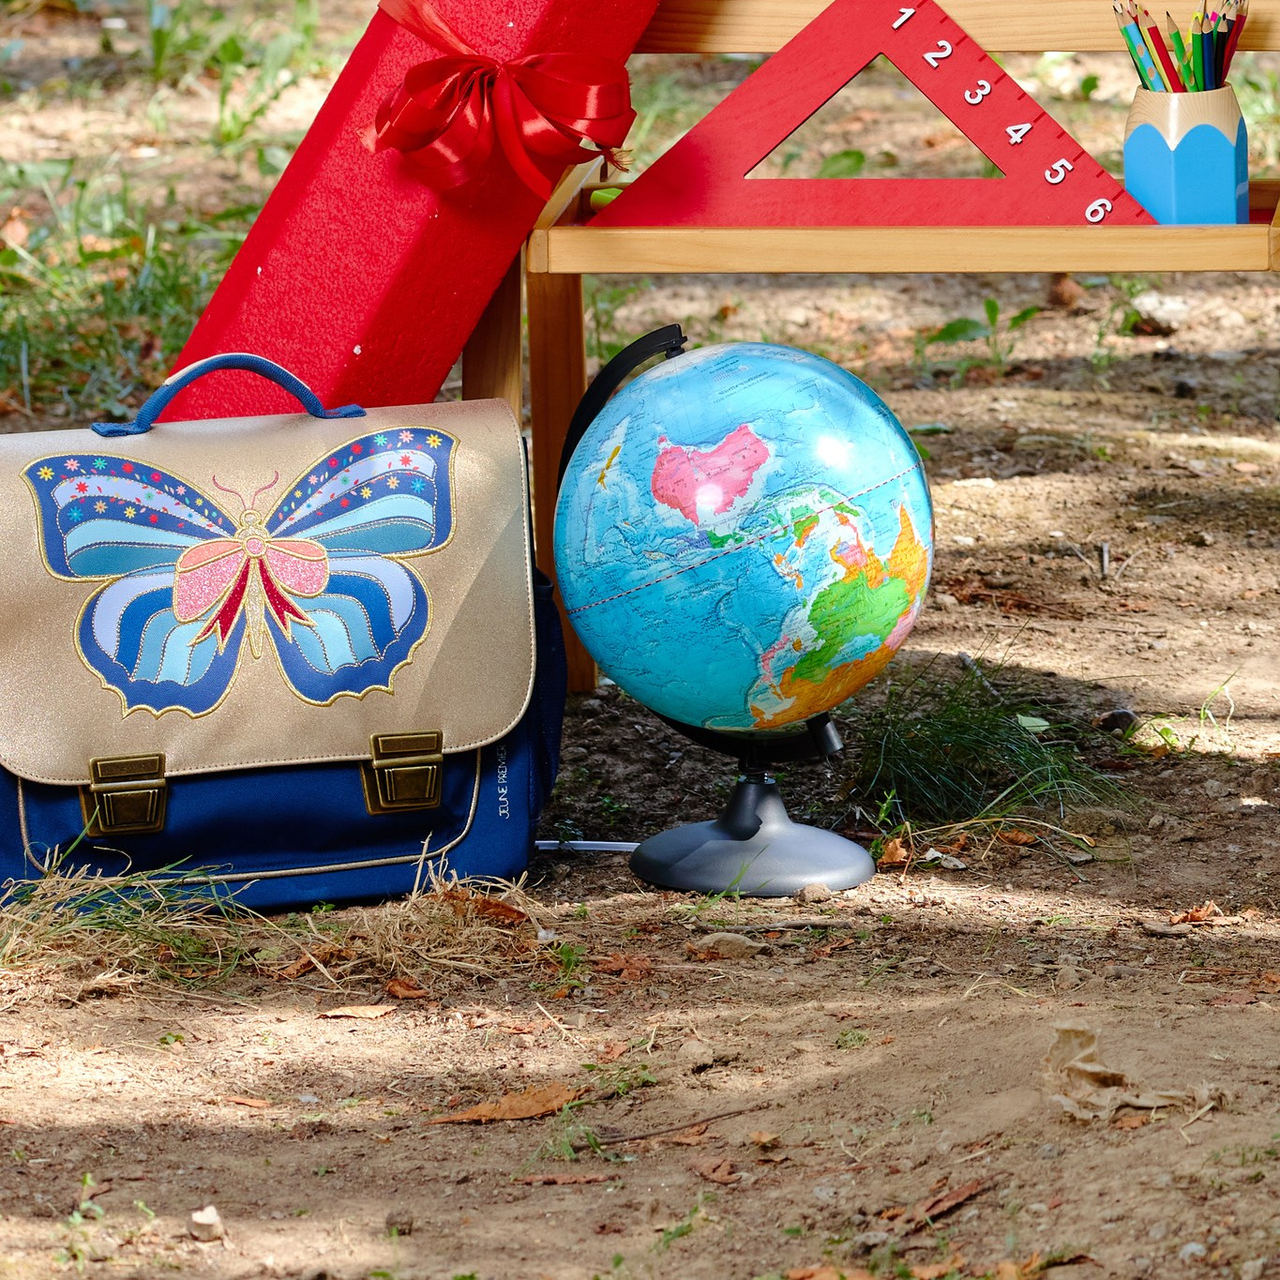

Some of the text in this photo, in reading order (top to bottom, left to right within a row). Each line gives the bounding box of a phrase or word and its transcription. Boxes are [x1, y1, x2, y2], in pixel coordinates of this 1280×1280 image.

[890, 5, 1113, 223] 1 2 3 4 5 6
[497, 744, 509, 819] JEUNE PREMIER
